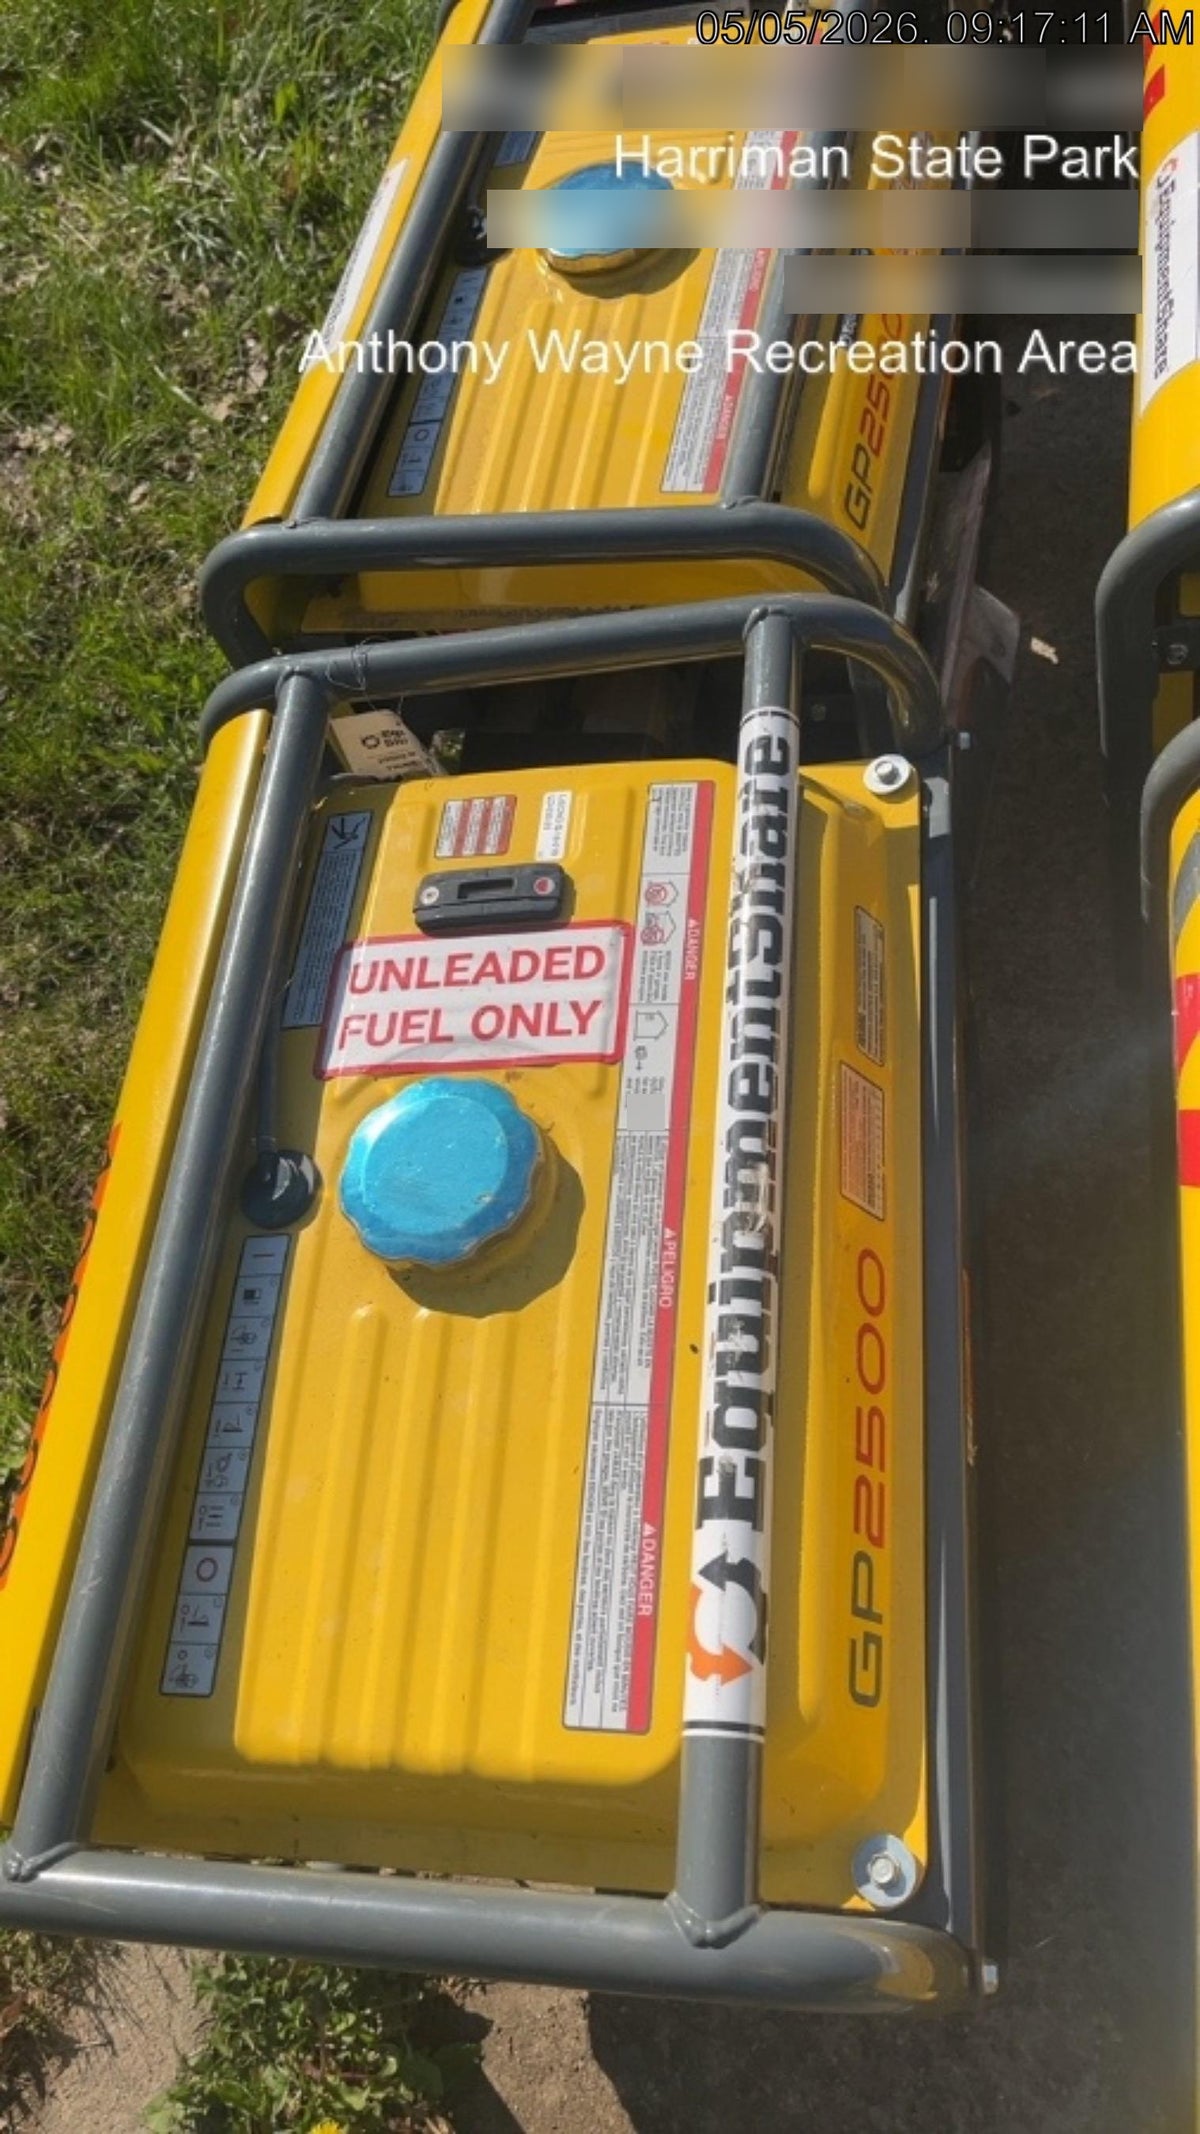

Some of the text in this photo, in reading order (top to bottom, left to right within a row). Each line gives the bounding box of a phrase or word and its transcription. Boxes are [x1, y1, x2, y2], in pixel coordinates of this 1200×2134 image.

[348, 945, 605, 994] UNLEADED
[684, 928, 700, 980] DANGER
[338, 1001, 603, 1051] FUEL ONLY
[659, 1241, 677, 1308] PELIGRO
[848, 1250, 886, 1708] GP2500
[637, 1539, 656, 1616] DANGER
